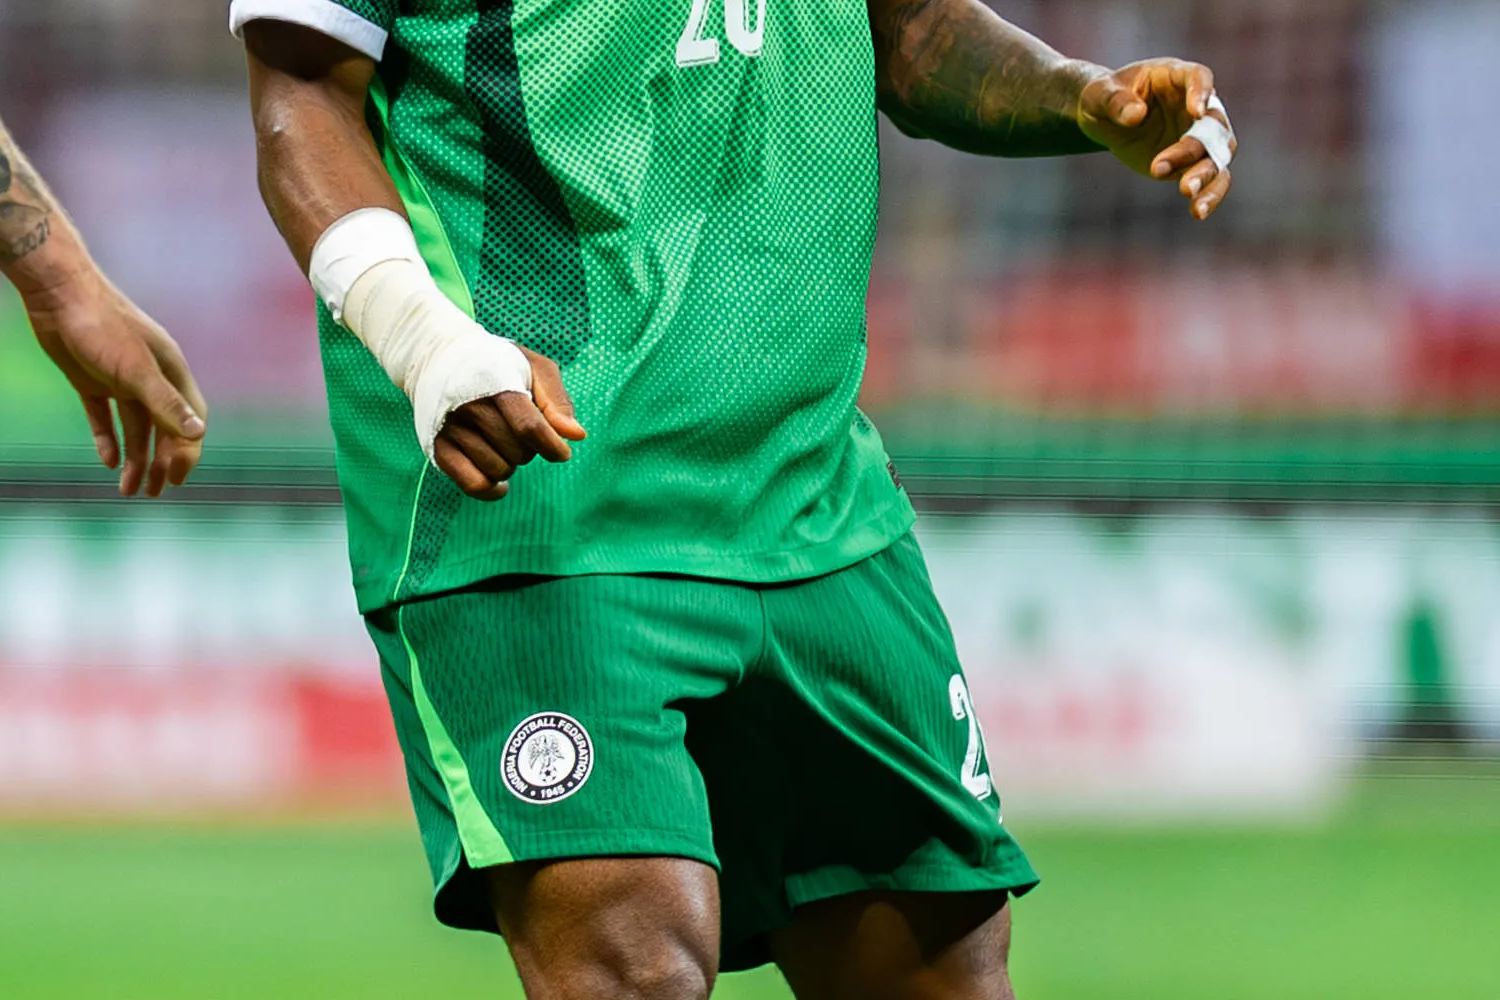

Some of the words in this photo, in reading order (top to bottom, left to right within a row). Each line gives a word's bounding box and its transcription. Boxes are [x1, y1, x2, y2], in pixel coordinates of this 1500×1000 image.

[508, 717, 557, 754] FOOTBALL
[557, 719, 590, 781] FEDERATION
[948, 673, 992, 801] 2
[540, 784, 566, 798] 1945
